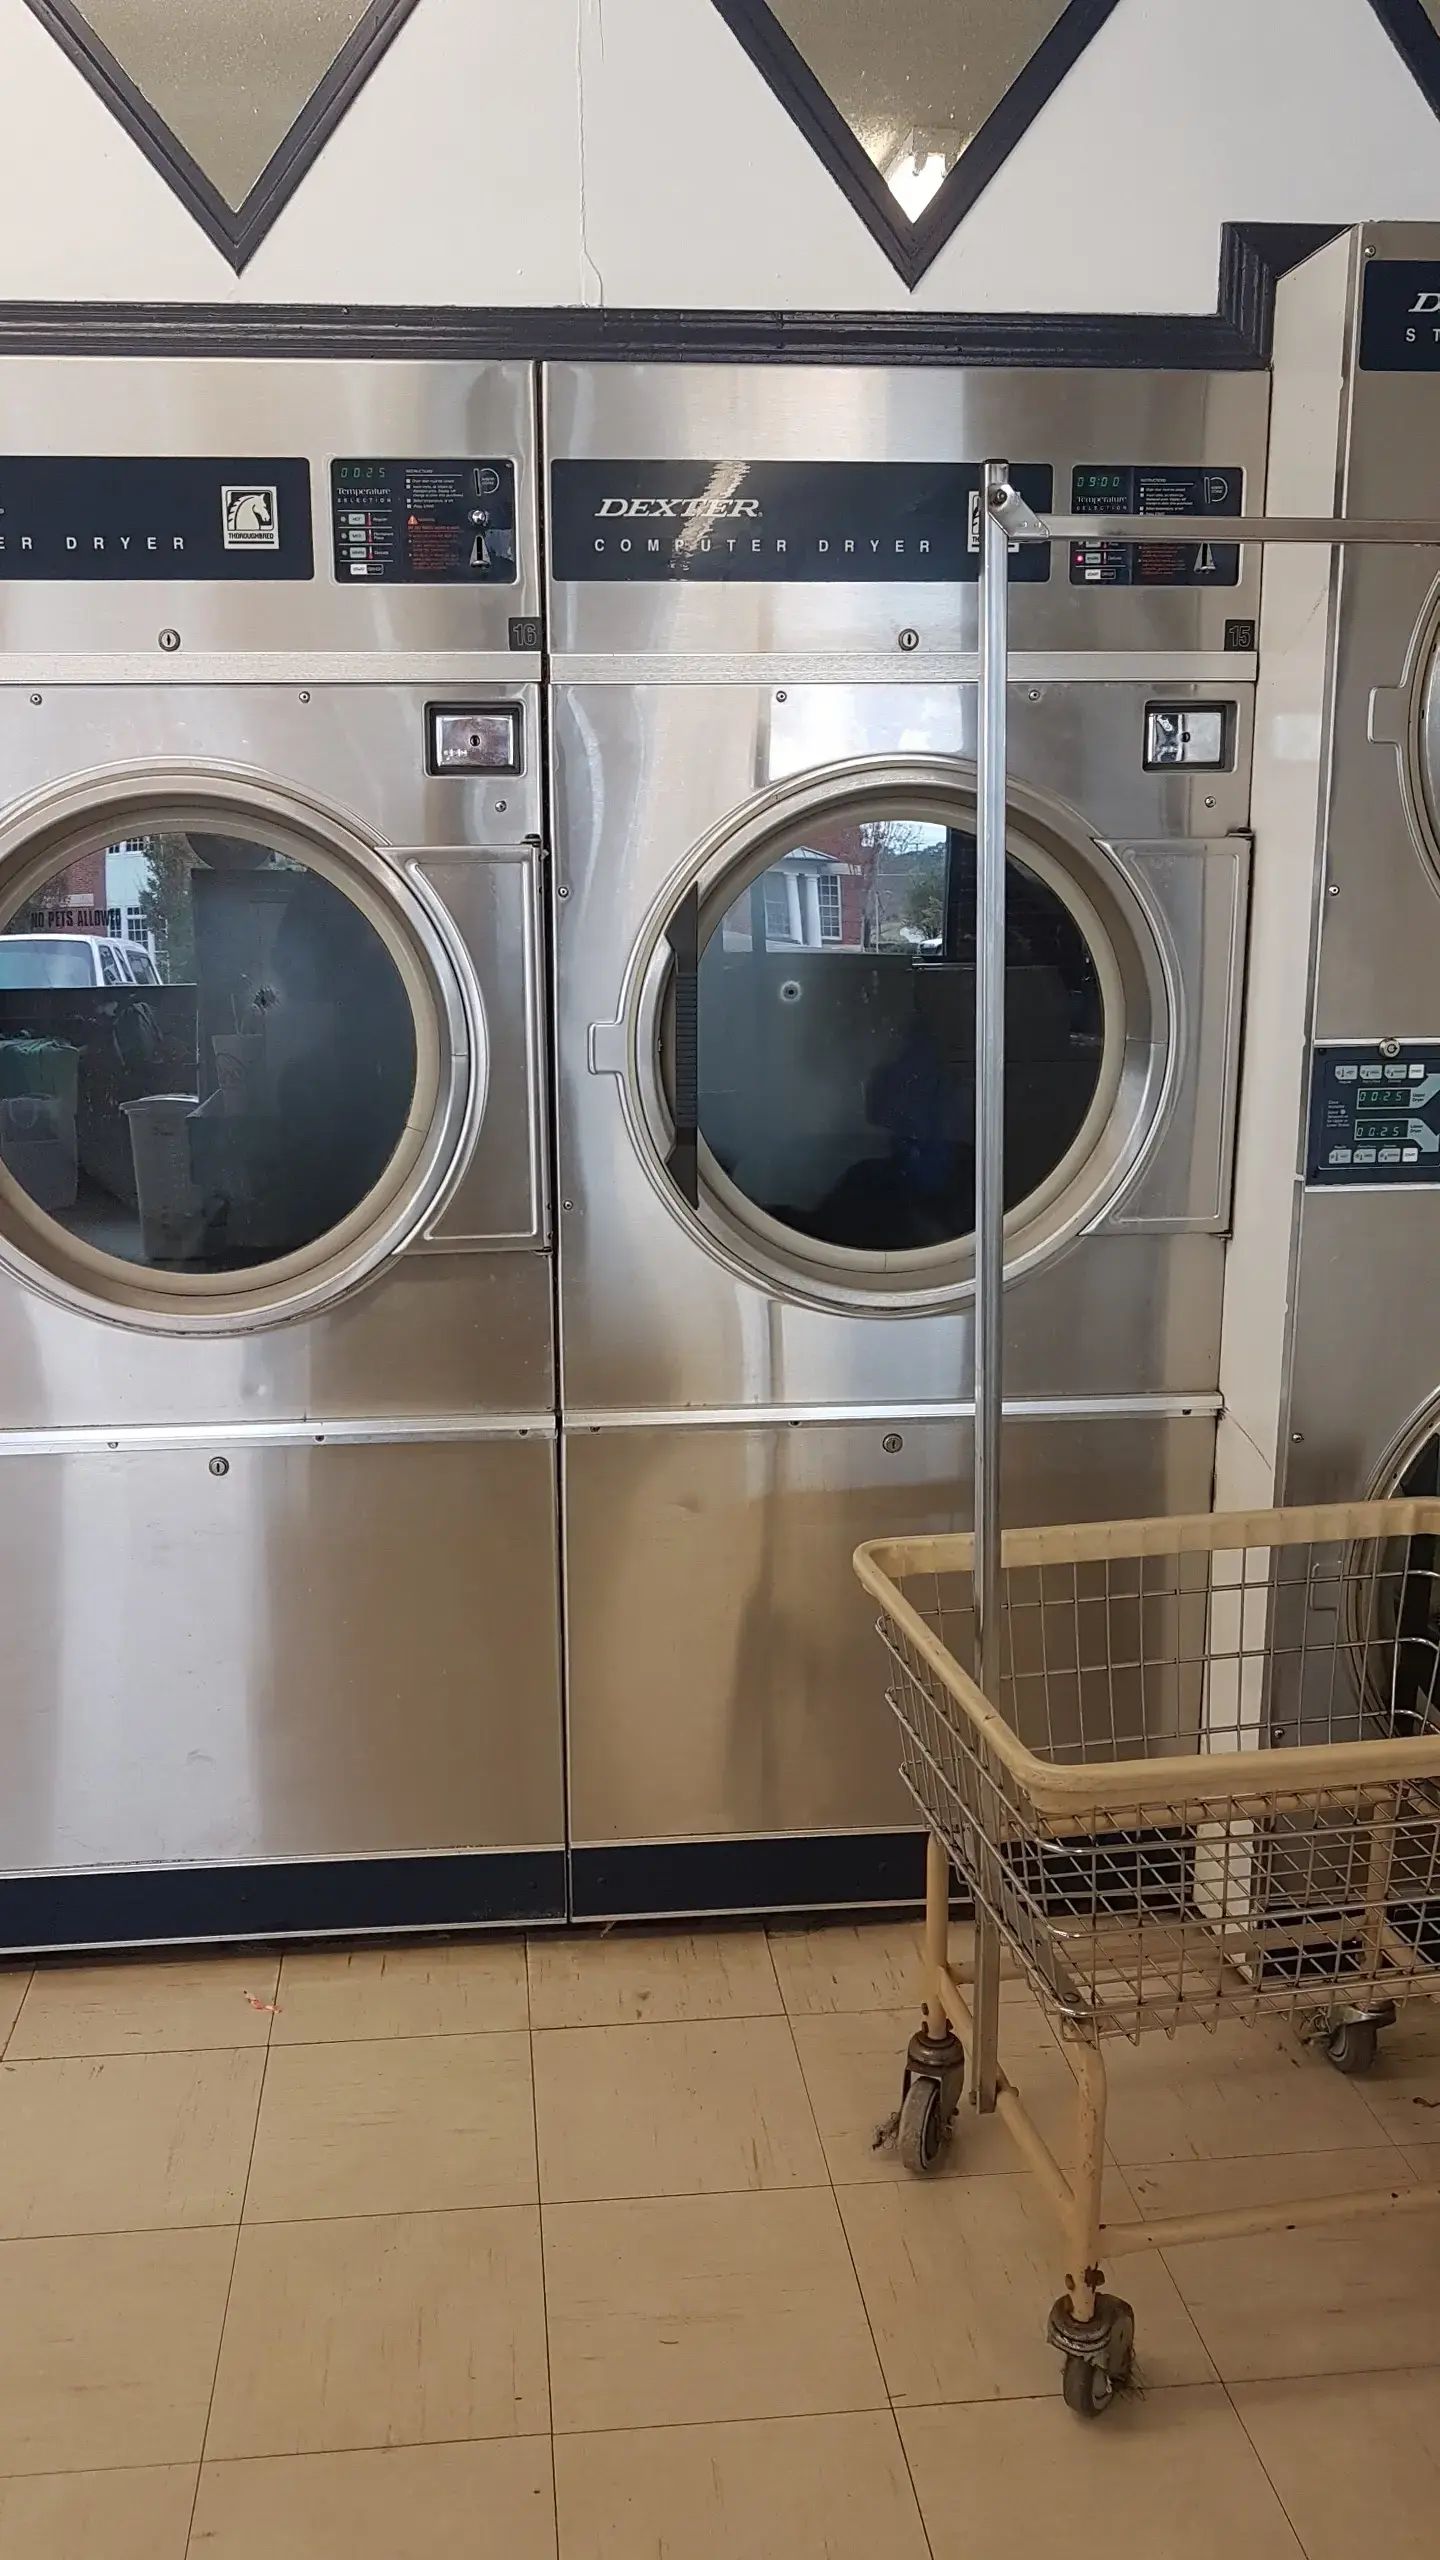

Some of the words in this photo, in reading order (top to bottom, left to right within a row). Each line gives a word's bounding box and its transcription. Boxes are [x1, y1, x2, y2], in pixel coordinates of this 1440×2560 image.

[336, 487, 391, 496] Temperature
[1076, 496, 1127, 504] Temperature
[594, 498, 759, 518] DEXTER
[66, 536, 184, 550] DRYER
[228, 532, 274, 540] THOROUGHBRED
[594, 538, 786, 553] COMPUTER
[819, 539, 931, 553] DRYER
[513, 623, 537, 646] 16
[1229, 625, 1251, 647] 15
[31, 911, 45, 928] NO
[48, 910, 74, 928] PETS
[77, 909, 122, 927] ALLOWED
